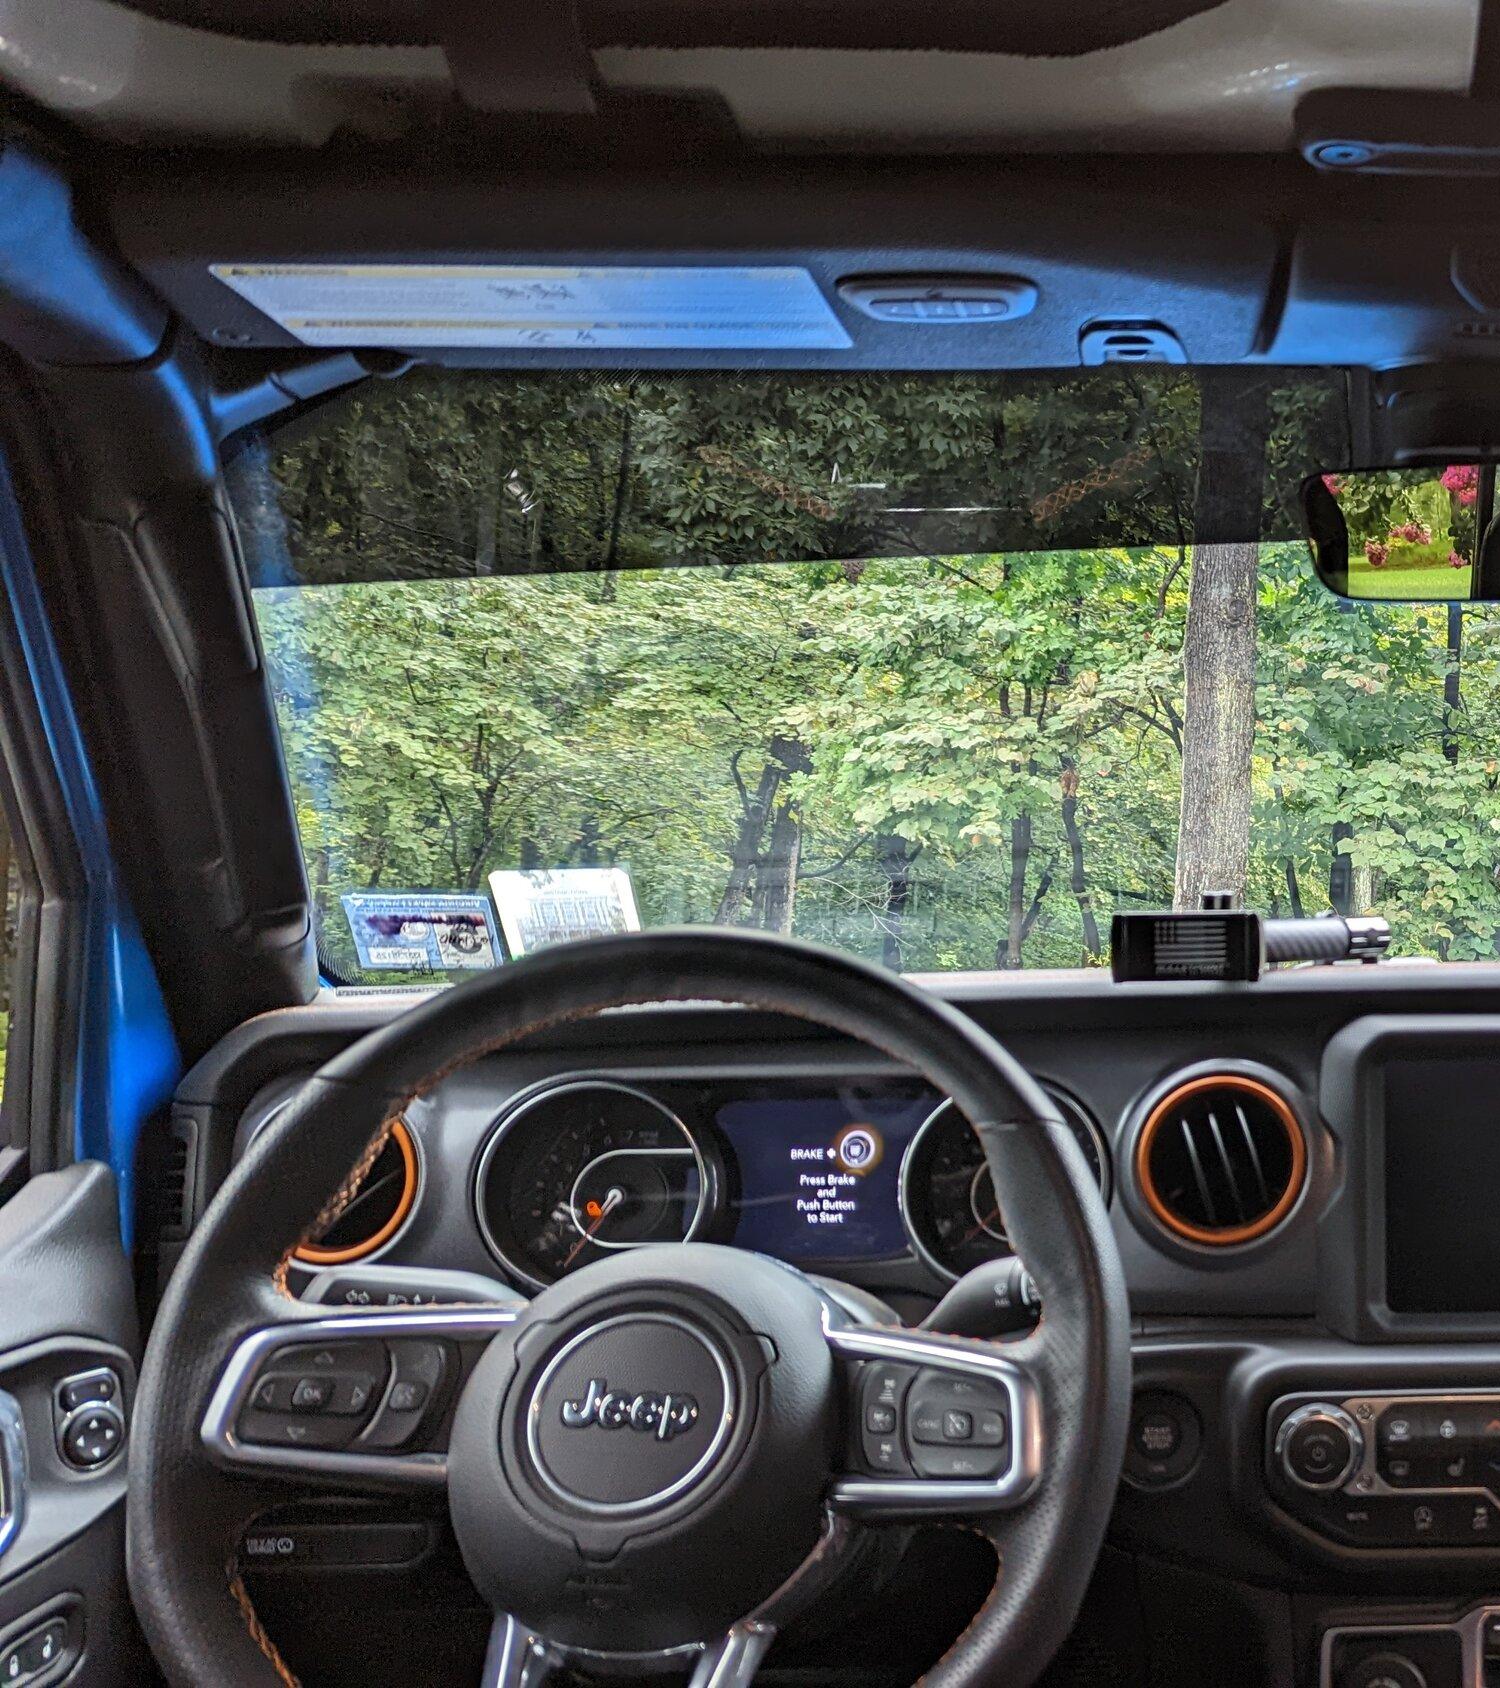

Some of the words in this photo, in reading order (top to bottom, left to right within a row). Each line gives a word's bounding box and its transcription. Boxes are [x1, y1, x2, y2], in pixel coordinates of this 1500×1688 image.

[790, 1148, 824, 1160] BRAKE
[799, 1174, 826, 1186] Press
[827, 1173, 856, 1186] Brake
[816, 1186, 837, 1198] and
[796, 1198, 821, 1211] Push
[822, 1199, 856, 1211] Button
[806, 1213, 819, 1223] to
[819, 1211, 844, 1223] Start
[561, 1378, 700, 1442] Jeep
